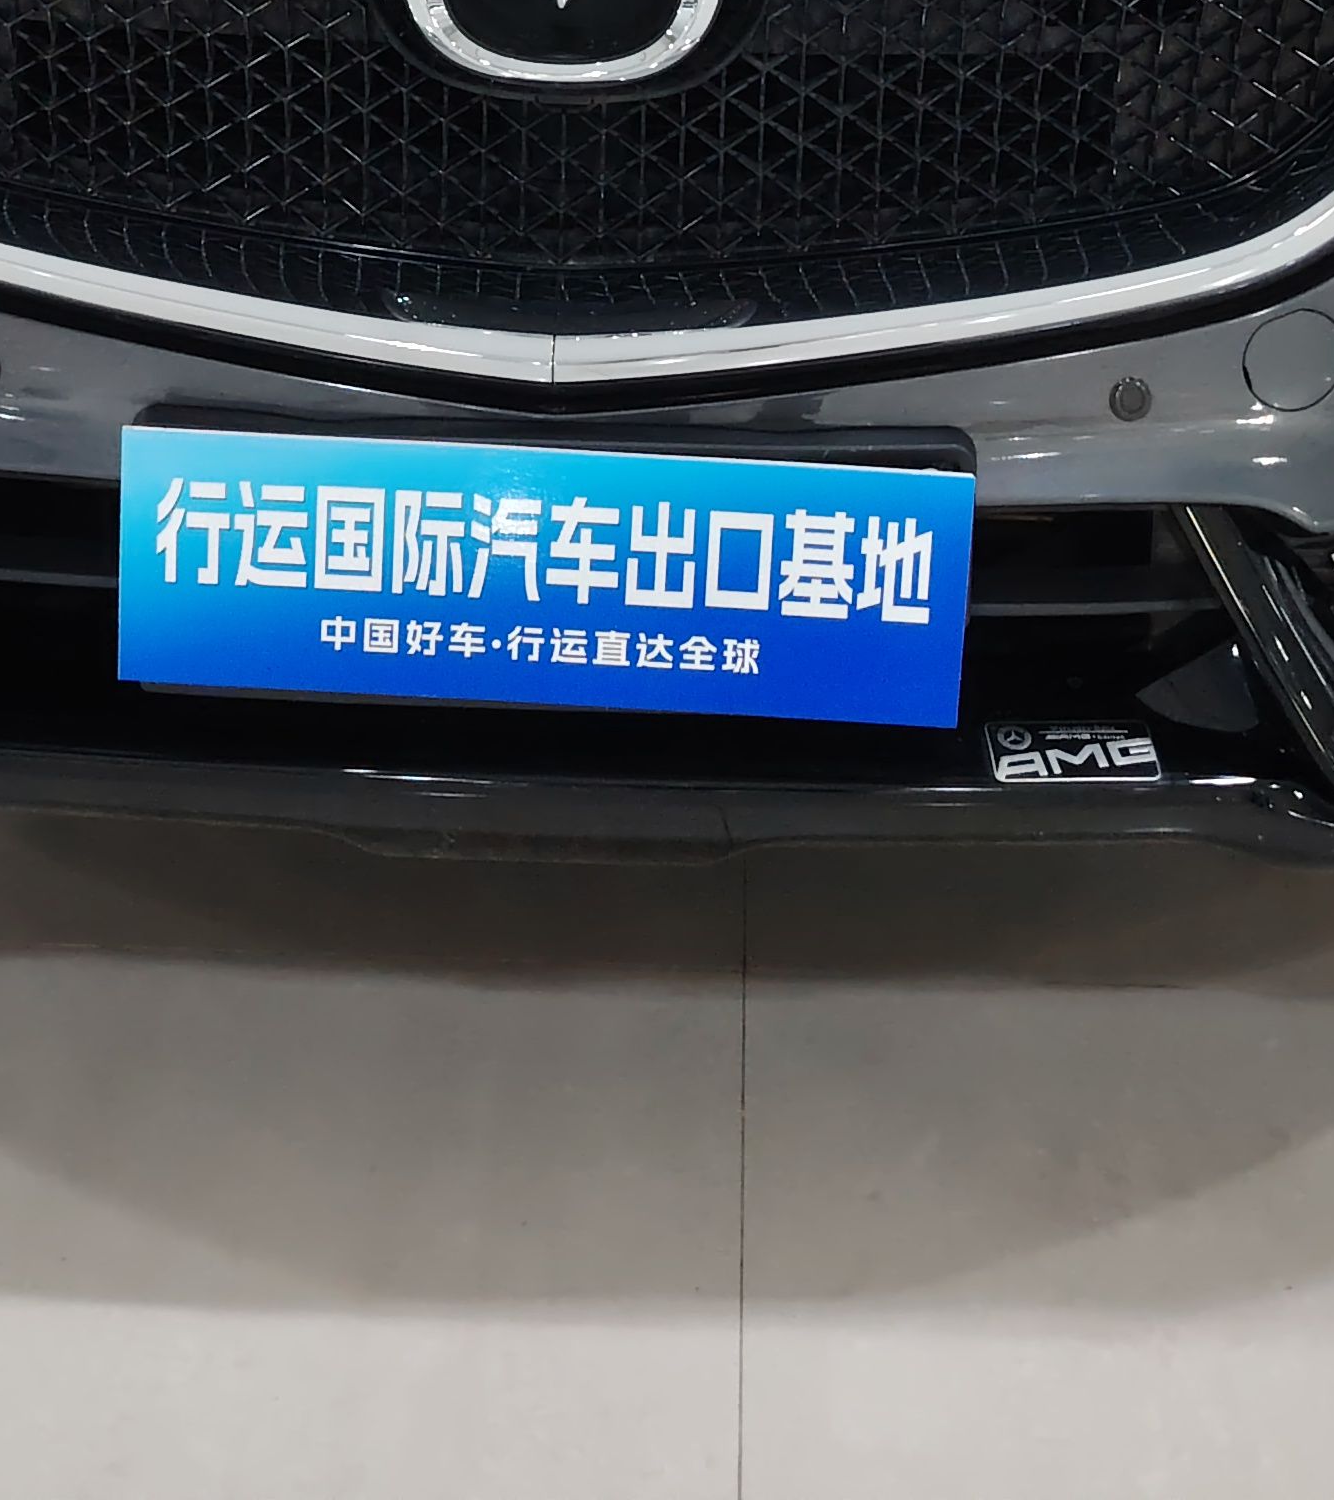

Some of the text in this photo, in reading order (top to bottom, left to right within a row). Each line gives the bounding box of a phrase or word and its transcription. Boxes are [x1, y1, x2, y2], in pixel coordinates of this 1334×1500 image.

[155, 476, 934, 625] 行运国际汽车出口基地
[320, 615, 762, 675] 中国好车·行运直达全球
[995, 737, 1156, 779] AMG
